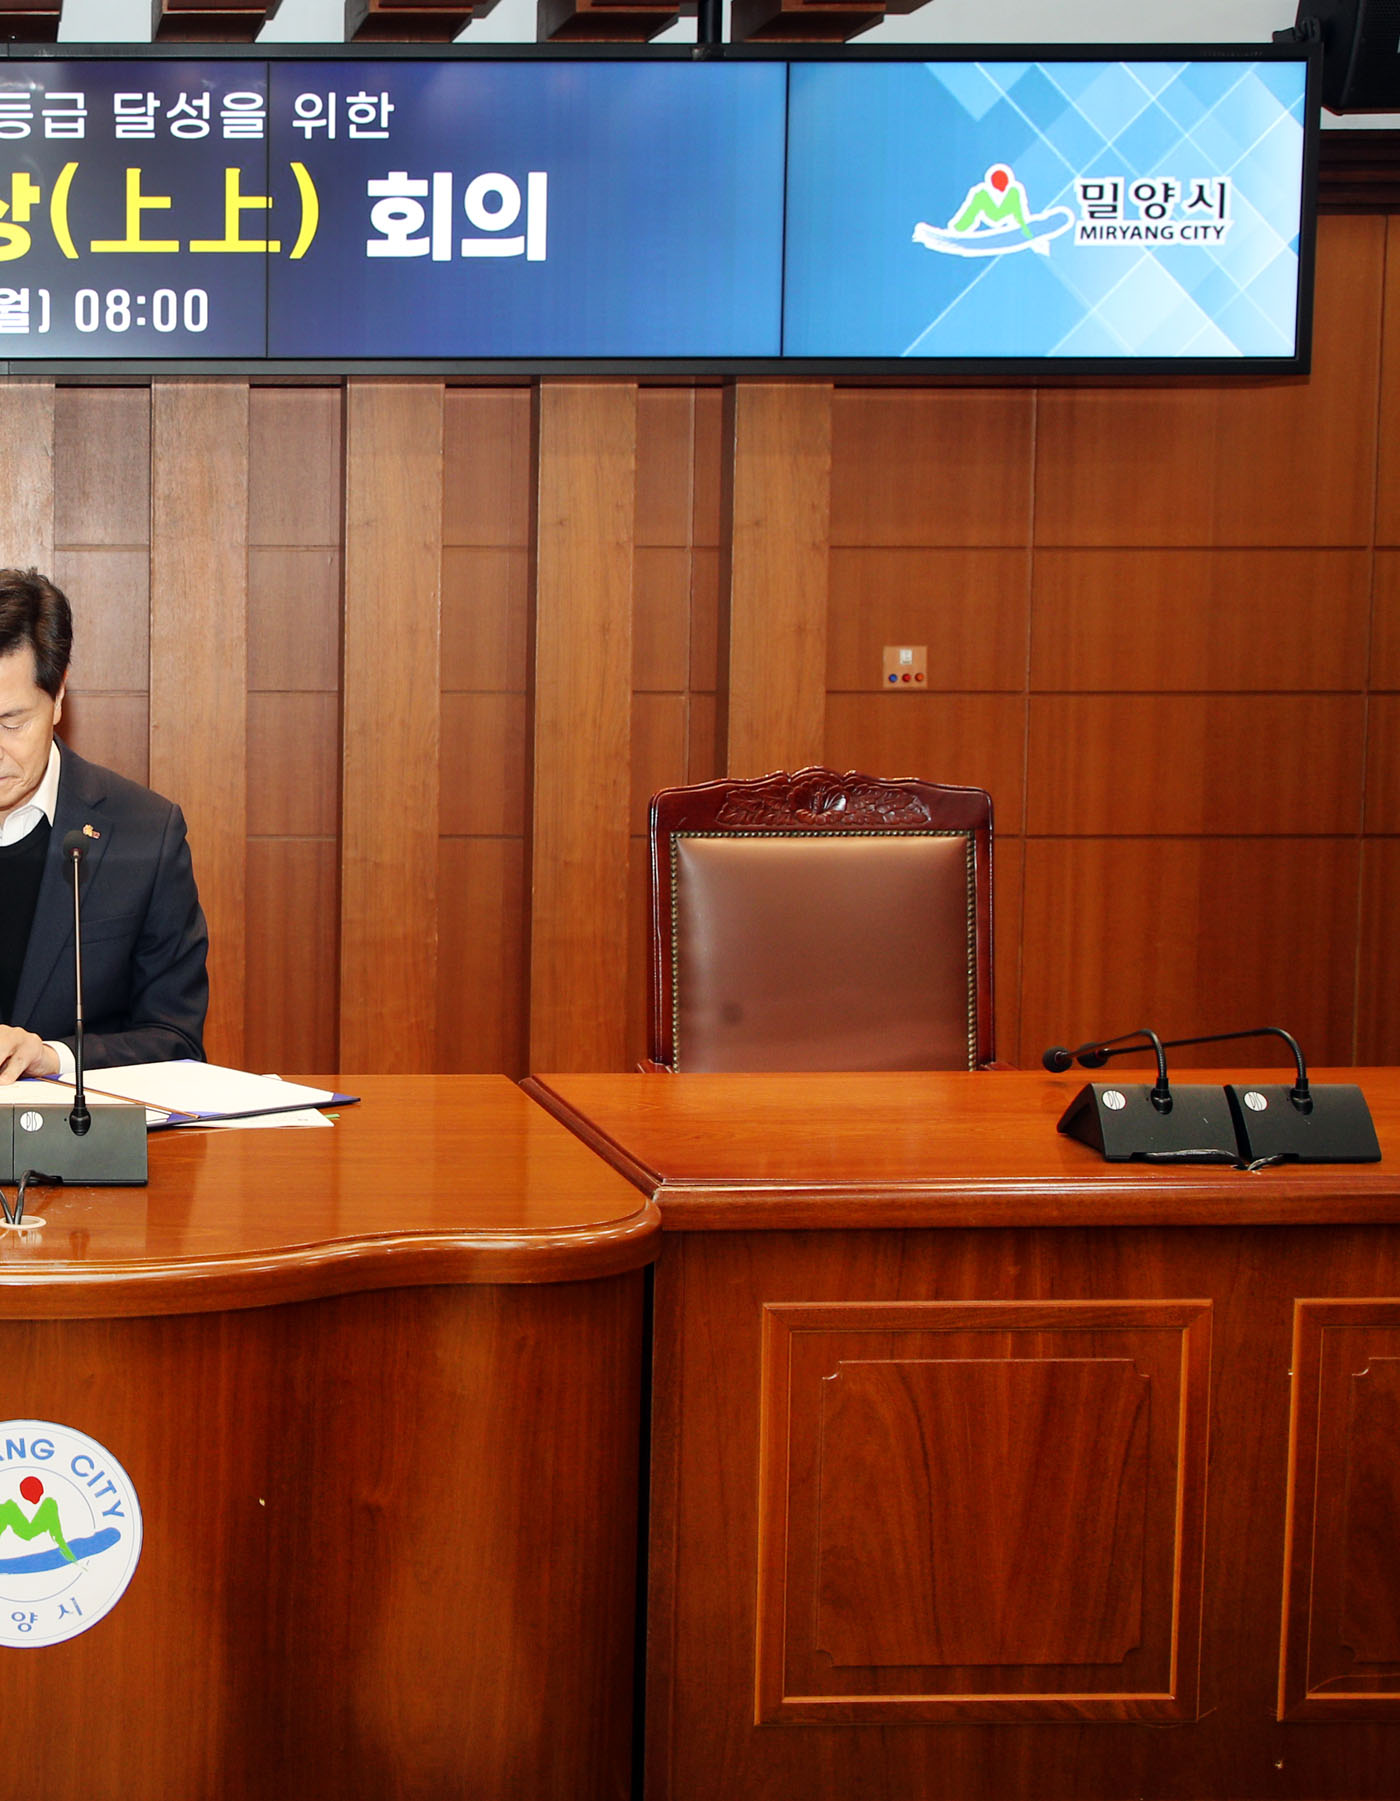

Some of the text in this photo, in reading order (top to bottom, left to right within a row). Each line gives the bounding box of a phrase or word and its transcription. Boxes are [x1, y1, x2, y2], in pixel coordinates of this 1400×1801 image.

[113, 91, 266, 139] 달성을
[292, 90, 396, 139] 위한
[366, 170, 549, 261] 회의
[1080, 181, 1226, 220] 밀양시
[1079, 225, 1226, 241] MIRYANG CITY
[74, 288, 209, 333] 08:00
[70, 1454, 126, 1520] CITY
